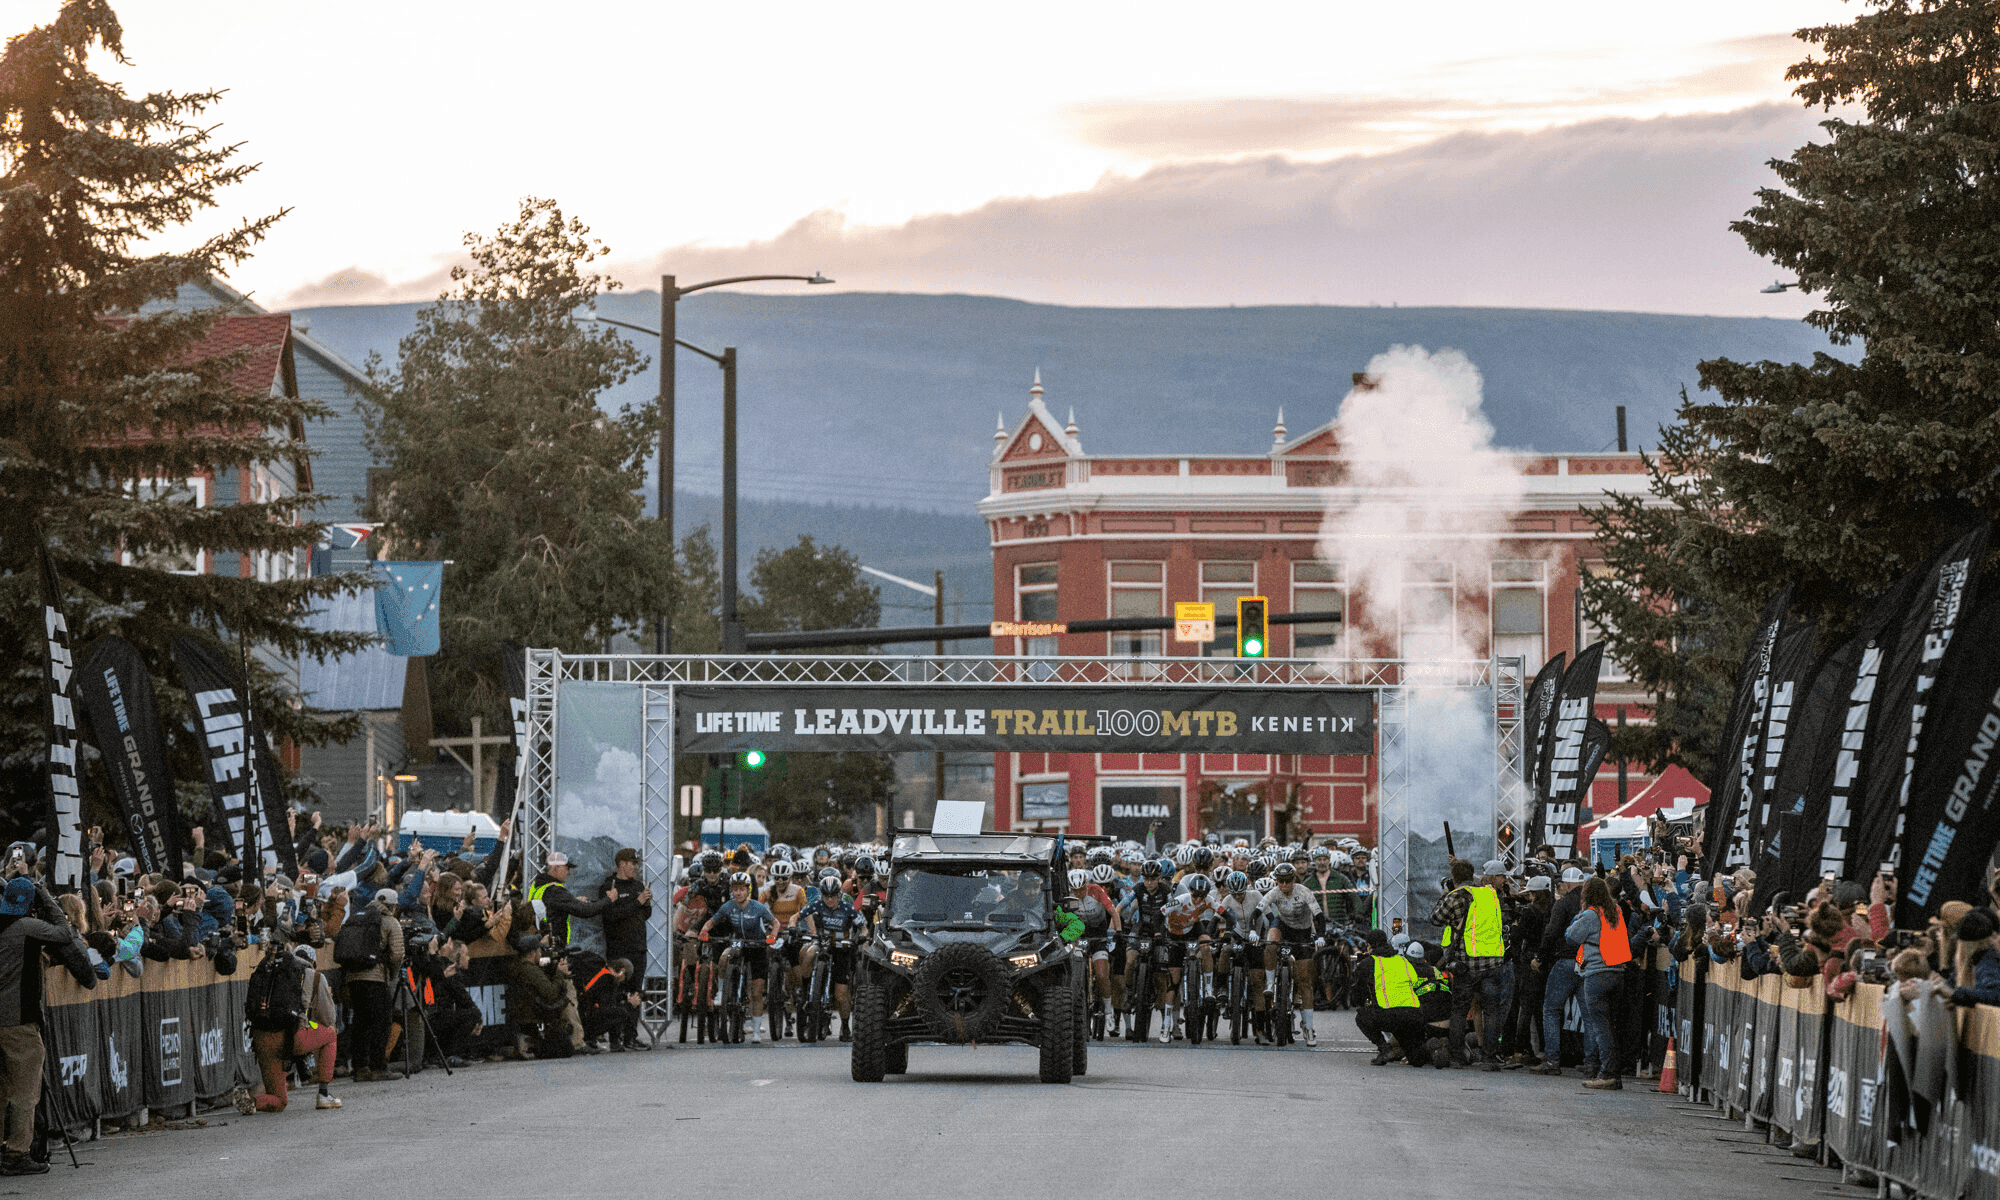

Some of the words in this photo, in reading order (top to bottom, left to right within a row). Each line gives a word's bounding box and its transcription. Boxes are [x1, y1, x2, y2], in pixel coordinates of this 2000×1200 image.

[794, 709, 985, 735] LEADVILLE
[1251, 715, 1354, 733] KENETIK
[1945, 712, 2000, 823] GRAND
[123, 735, 155, 817] GRAND
[148, 820, 170, 874] PRIX
